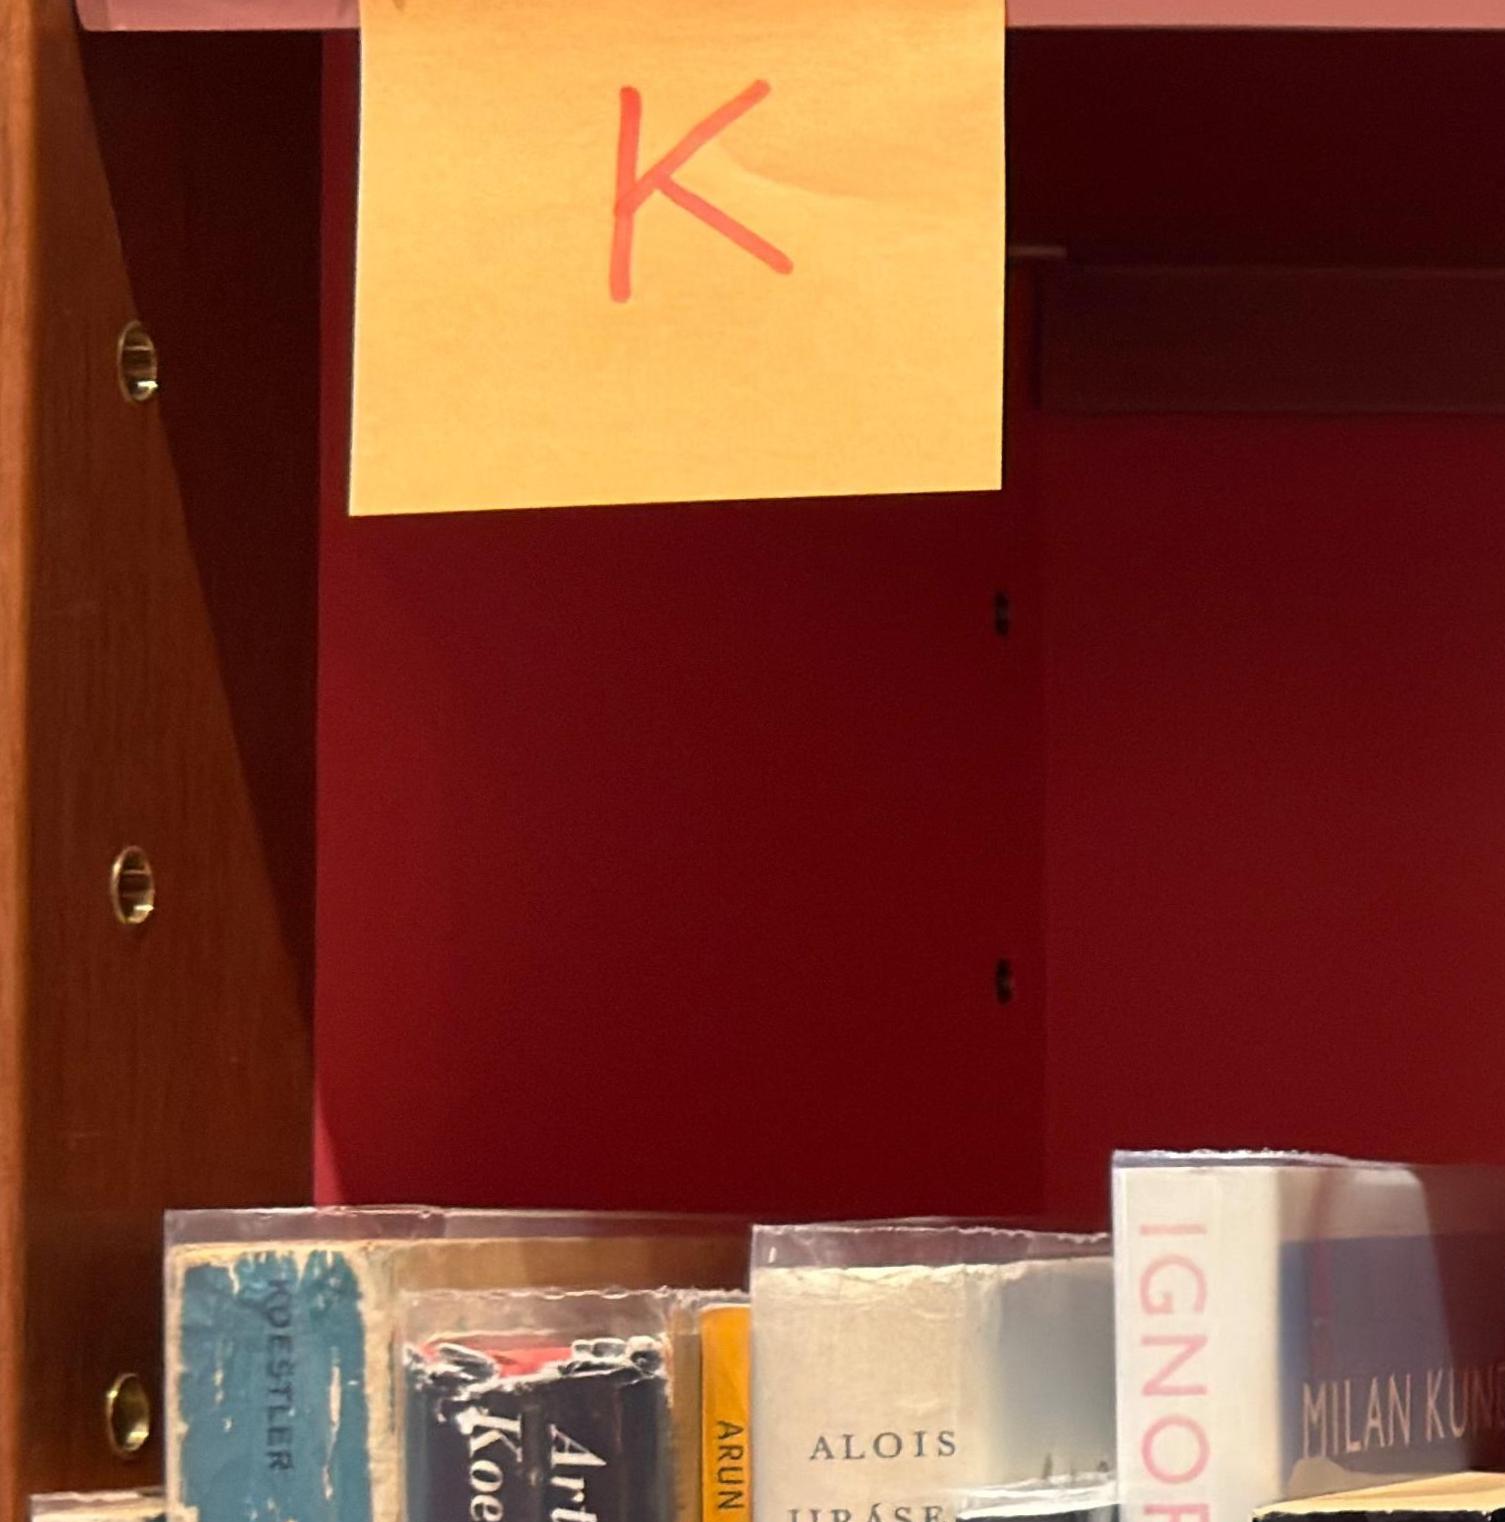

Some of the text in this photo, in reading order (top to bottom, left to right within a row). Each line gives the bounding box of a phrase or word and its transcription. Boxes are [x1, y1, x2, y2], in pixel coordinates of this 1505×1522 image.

[610, 78, 794, 303] K
[265, 1278, 296, 1470] KOESTLER
[1303, 1372, 1411, 1458] MILAN
[716, 1421, 743, 1509] ARUN
[809, 1430, 957, 1460] ALOIS
